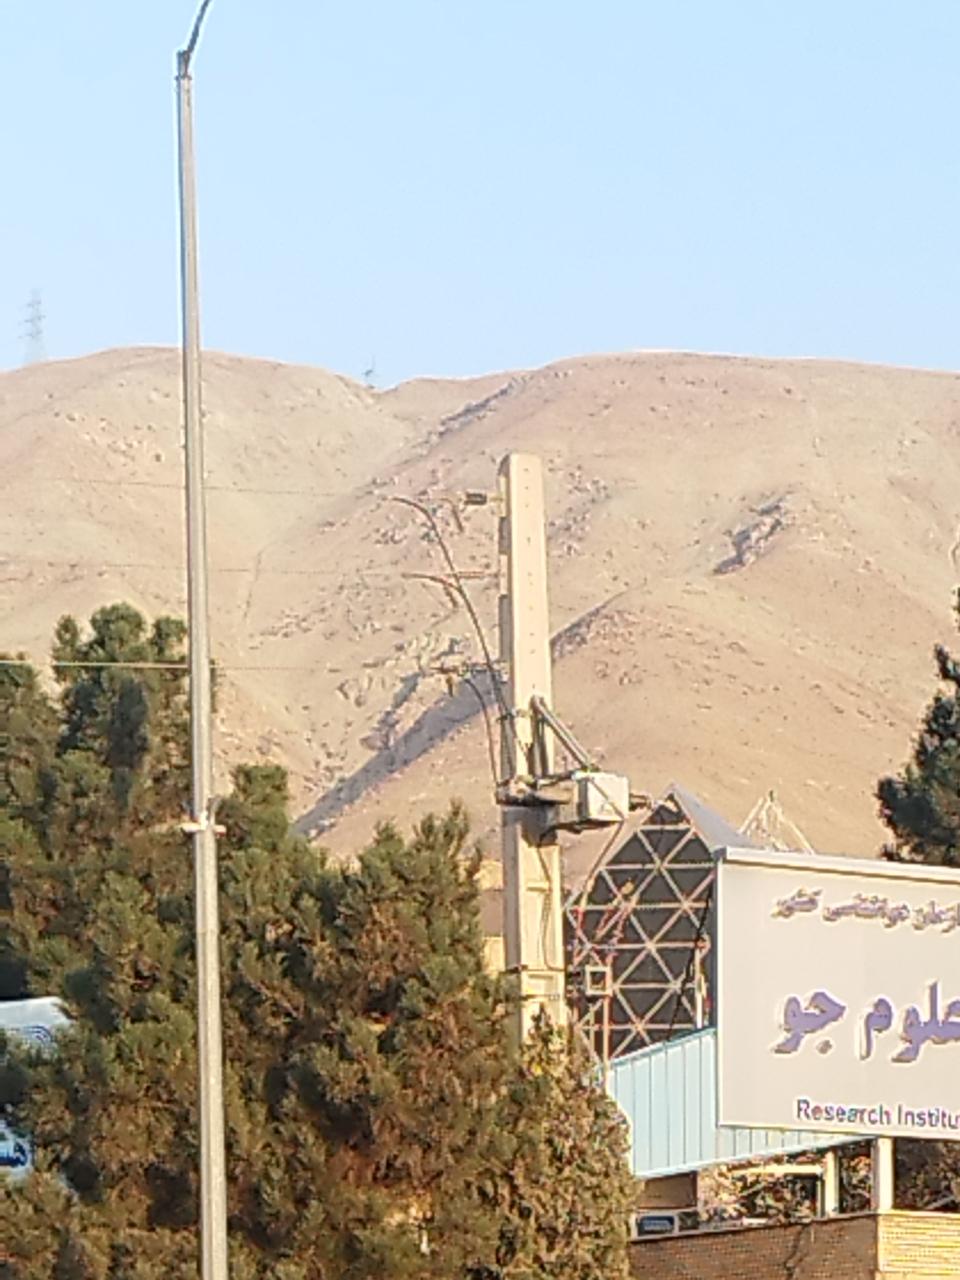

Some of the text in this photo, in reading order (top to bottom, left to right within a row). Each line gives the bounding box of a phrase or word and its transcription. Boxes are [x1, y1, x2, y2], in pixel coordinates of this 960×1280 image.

[770, 887, 823, 919] کشور
[821, 892, 910, 929] هواشناسی
[771, 990, 847, 1054] جو
[796, 1098, 892, 1127] Research
